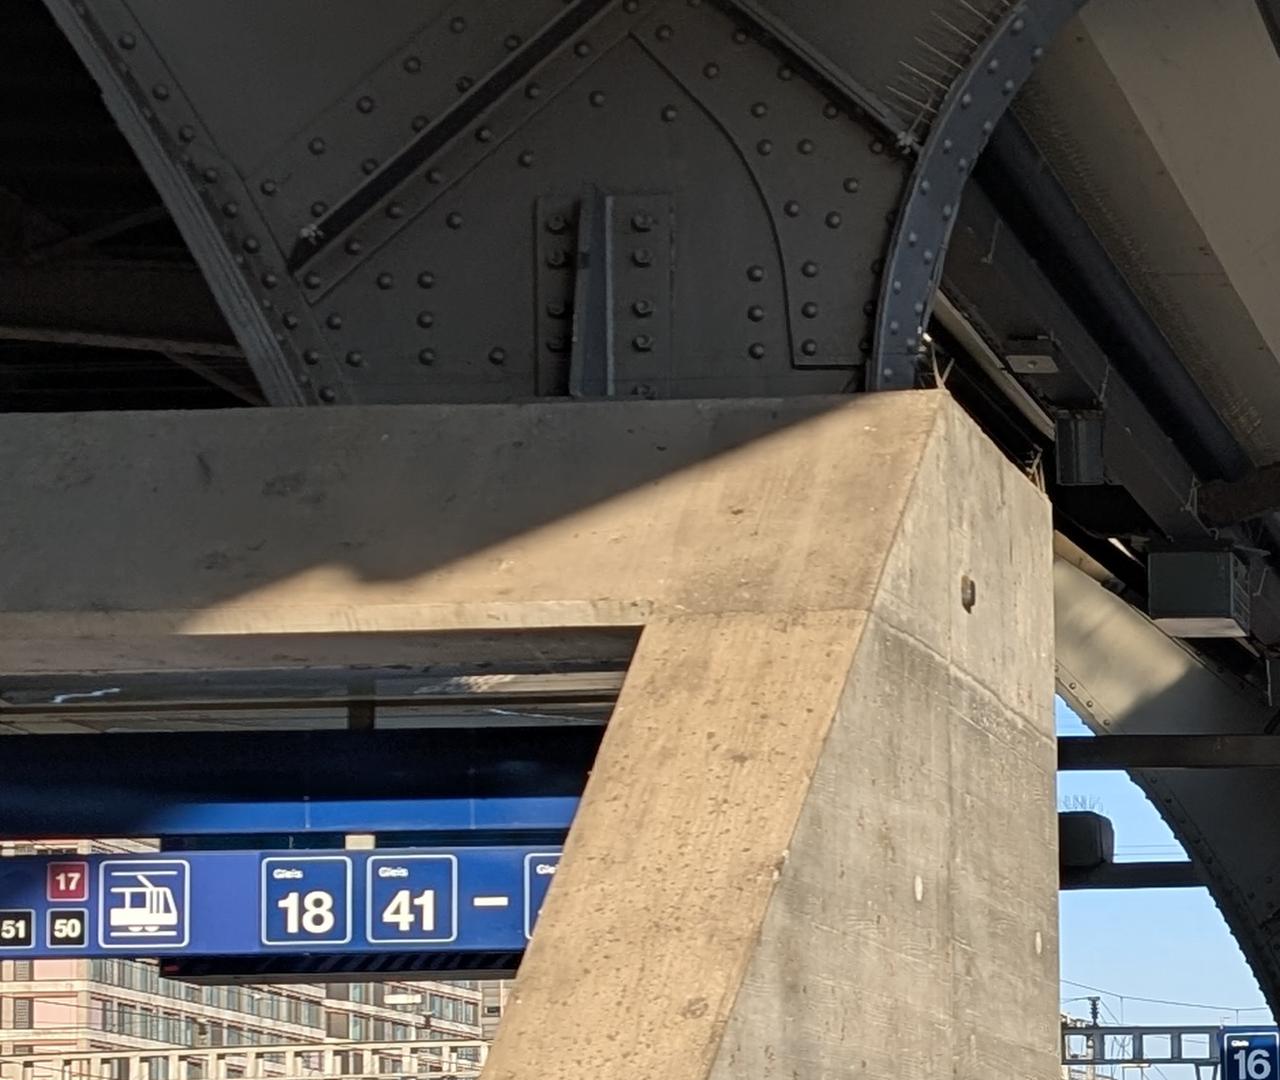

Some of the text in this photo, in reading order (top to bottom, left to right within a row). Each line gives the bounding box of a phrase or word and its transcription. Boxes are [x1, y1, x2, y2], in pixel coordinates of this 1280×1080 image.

[56, 872, 81, 891] 17
[277, 890, 335, 934] 18
[382, 889, 435, 931] 41
[1, 919, 81, 939] 51 50
[1233, 1049, 1271, 1080] 16
